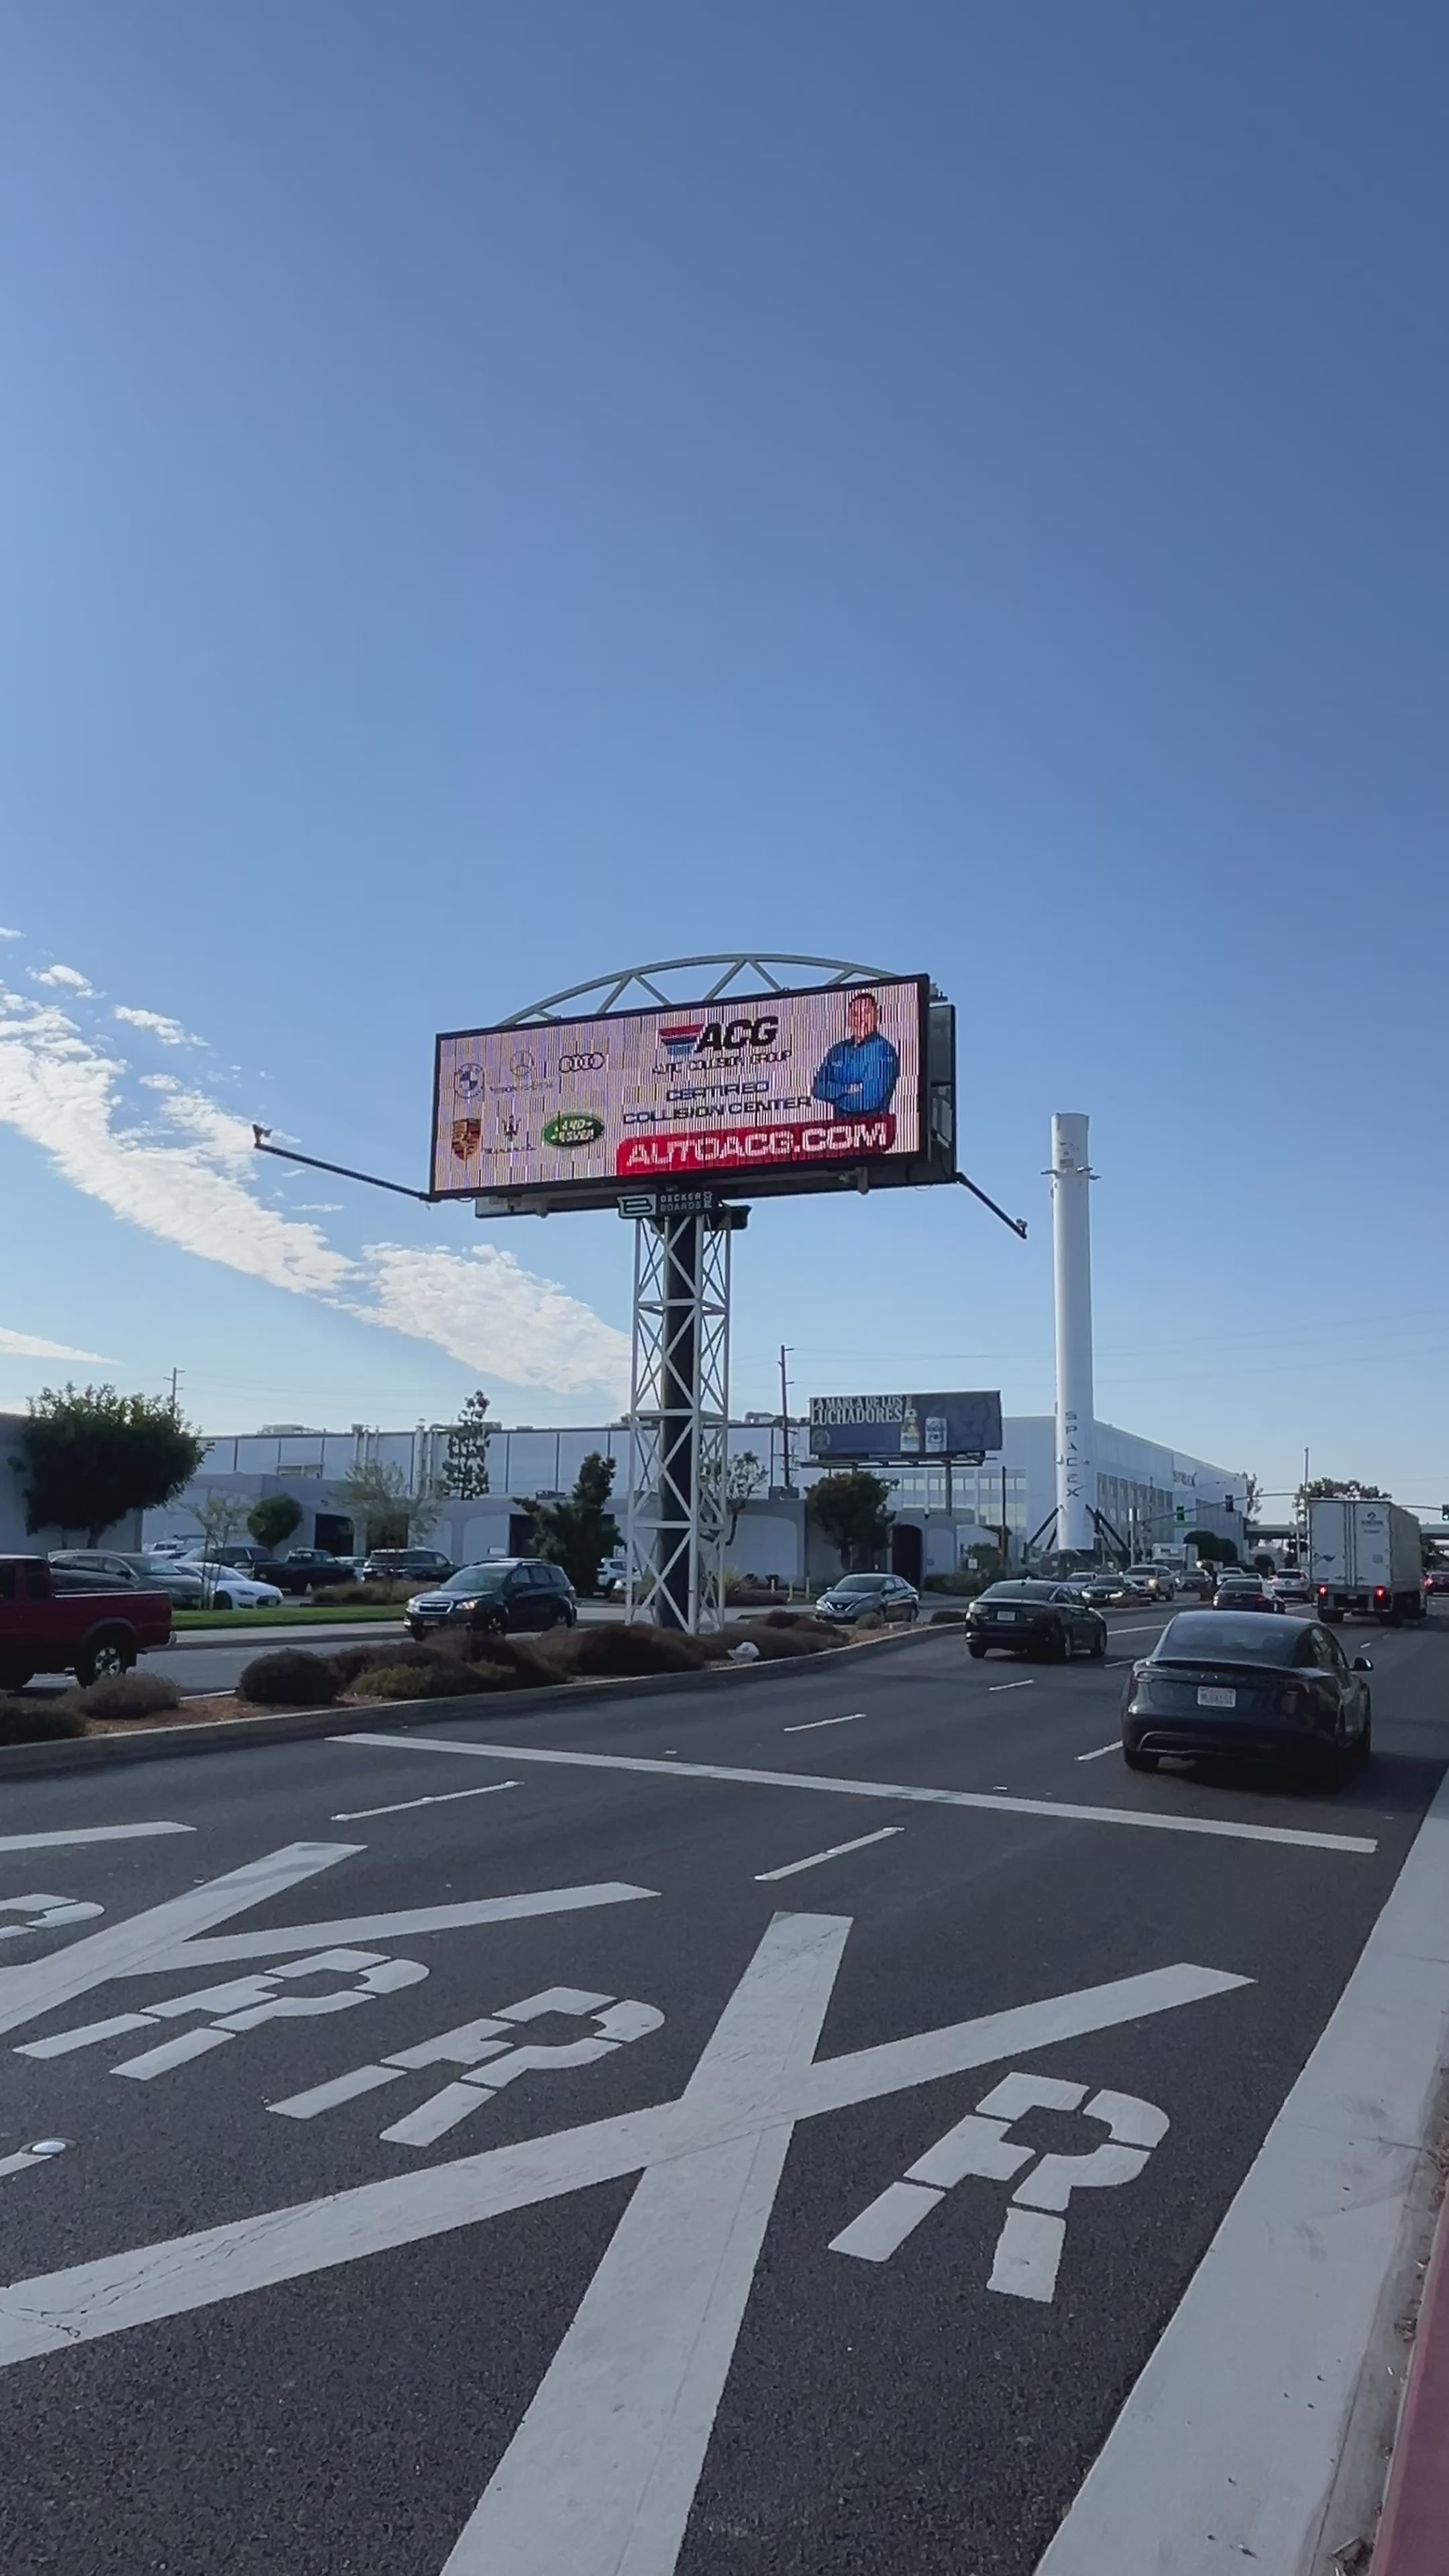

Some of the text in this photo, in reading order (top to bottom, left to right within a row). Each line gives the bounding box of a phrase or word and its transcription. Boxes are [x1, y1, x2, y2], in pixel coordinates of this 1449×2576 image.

[694, 1016, 779, 1053] ACG
[623, 1095, 812, 1124] COLLISION CENTER
[626, 1122, 887, 1166] AUTOACG.COM
[659, 1200, 702, 1212] BOARDS
[660, 1191, 702, 1203] BECKER
[810, 1395, 904, 1409] LA MARCA DE LOS
[810, 1407, 904, 1426] LUCHADORES
[827, 2072, 1171, 2304] R
